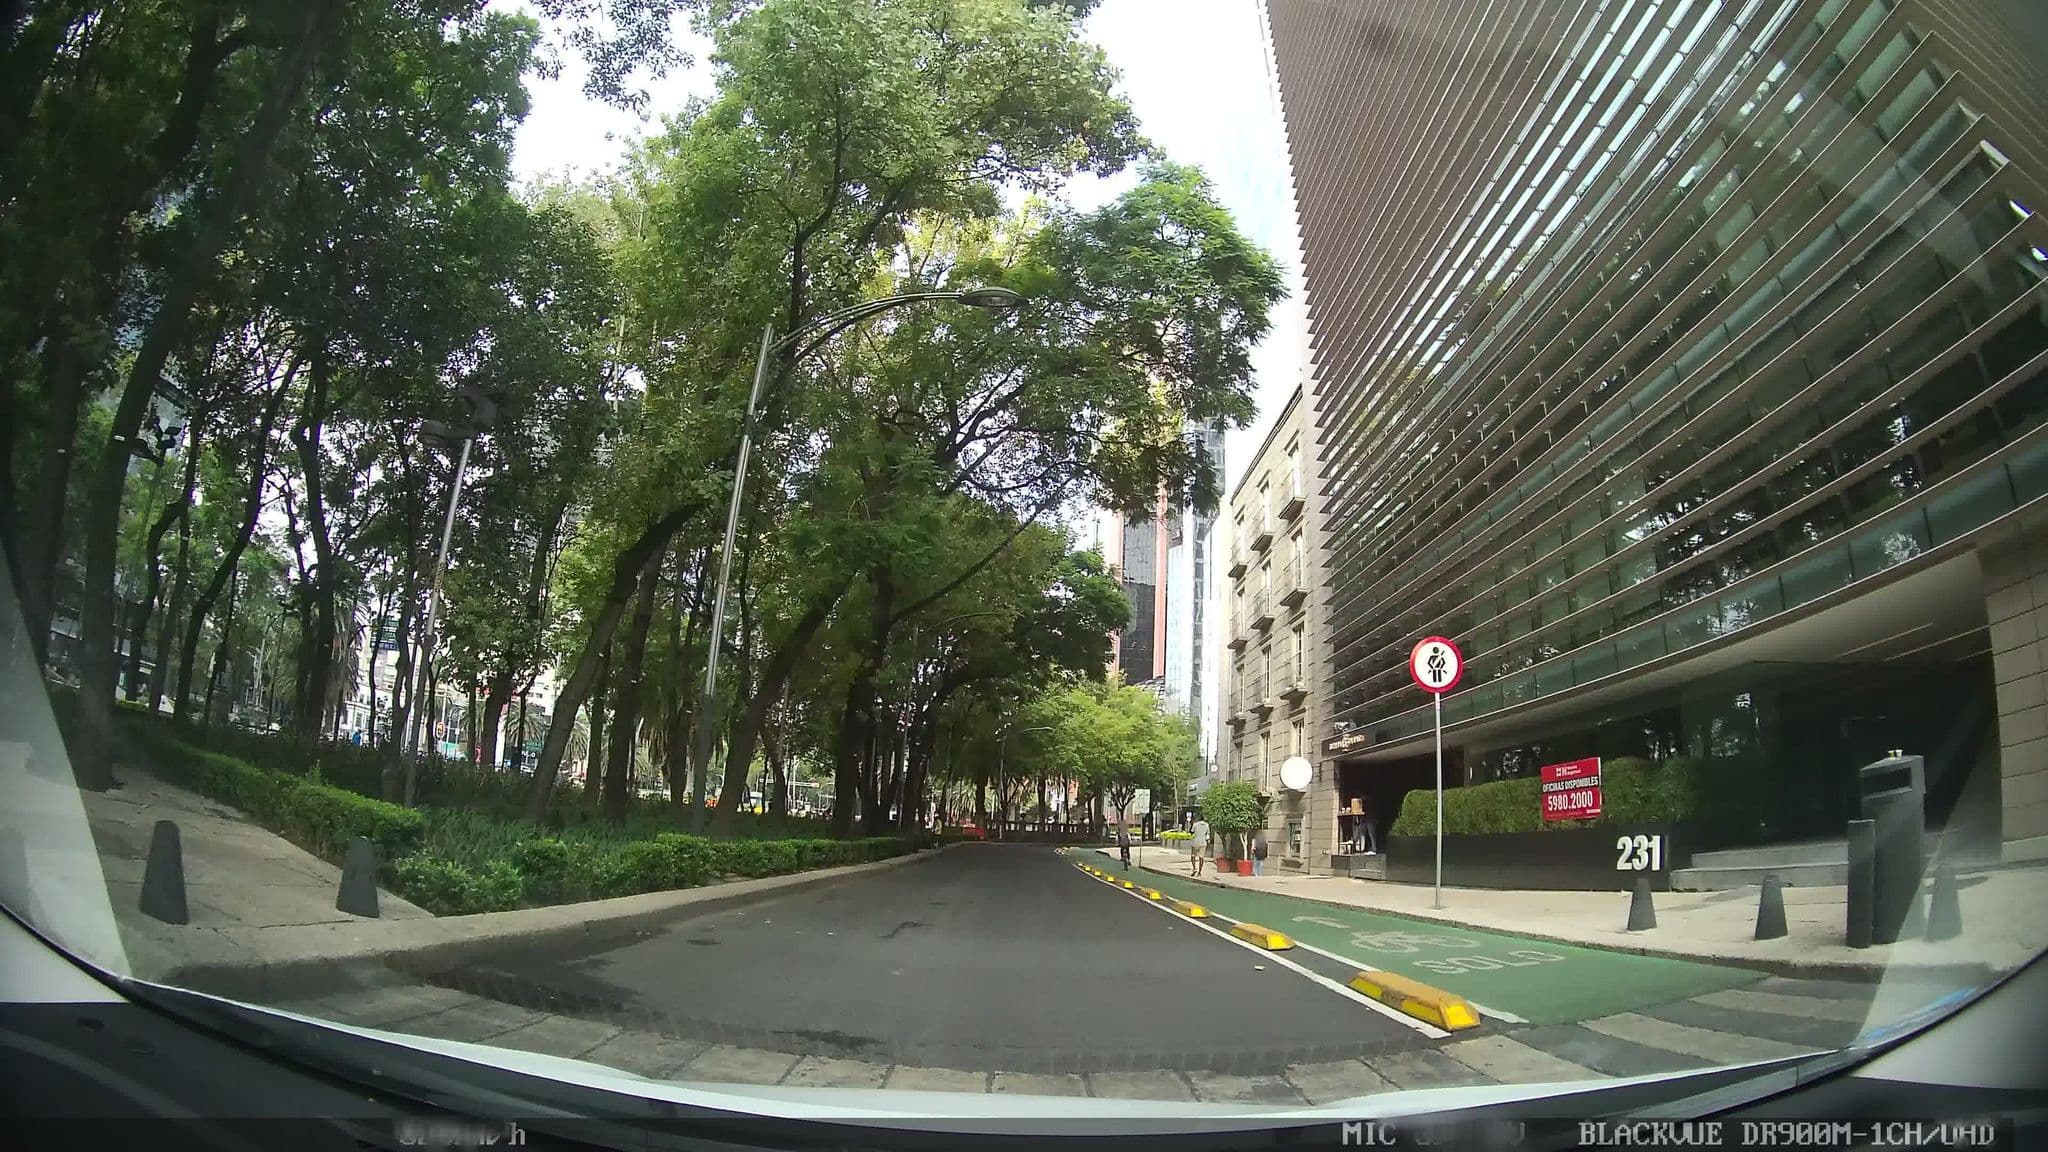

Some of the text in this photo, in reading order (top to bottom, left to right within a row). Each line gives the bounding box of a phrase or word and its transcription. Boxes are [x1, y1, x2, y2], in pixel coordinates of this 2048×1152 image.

[1543, 776, 1599, 793] OFICINAS DISPONIBLES
[1547, 790, 1593, 811] 5980.2000
[1616, 834, 1661, 871] 231
[1412, 950, 1567, 975] SOLO
